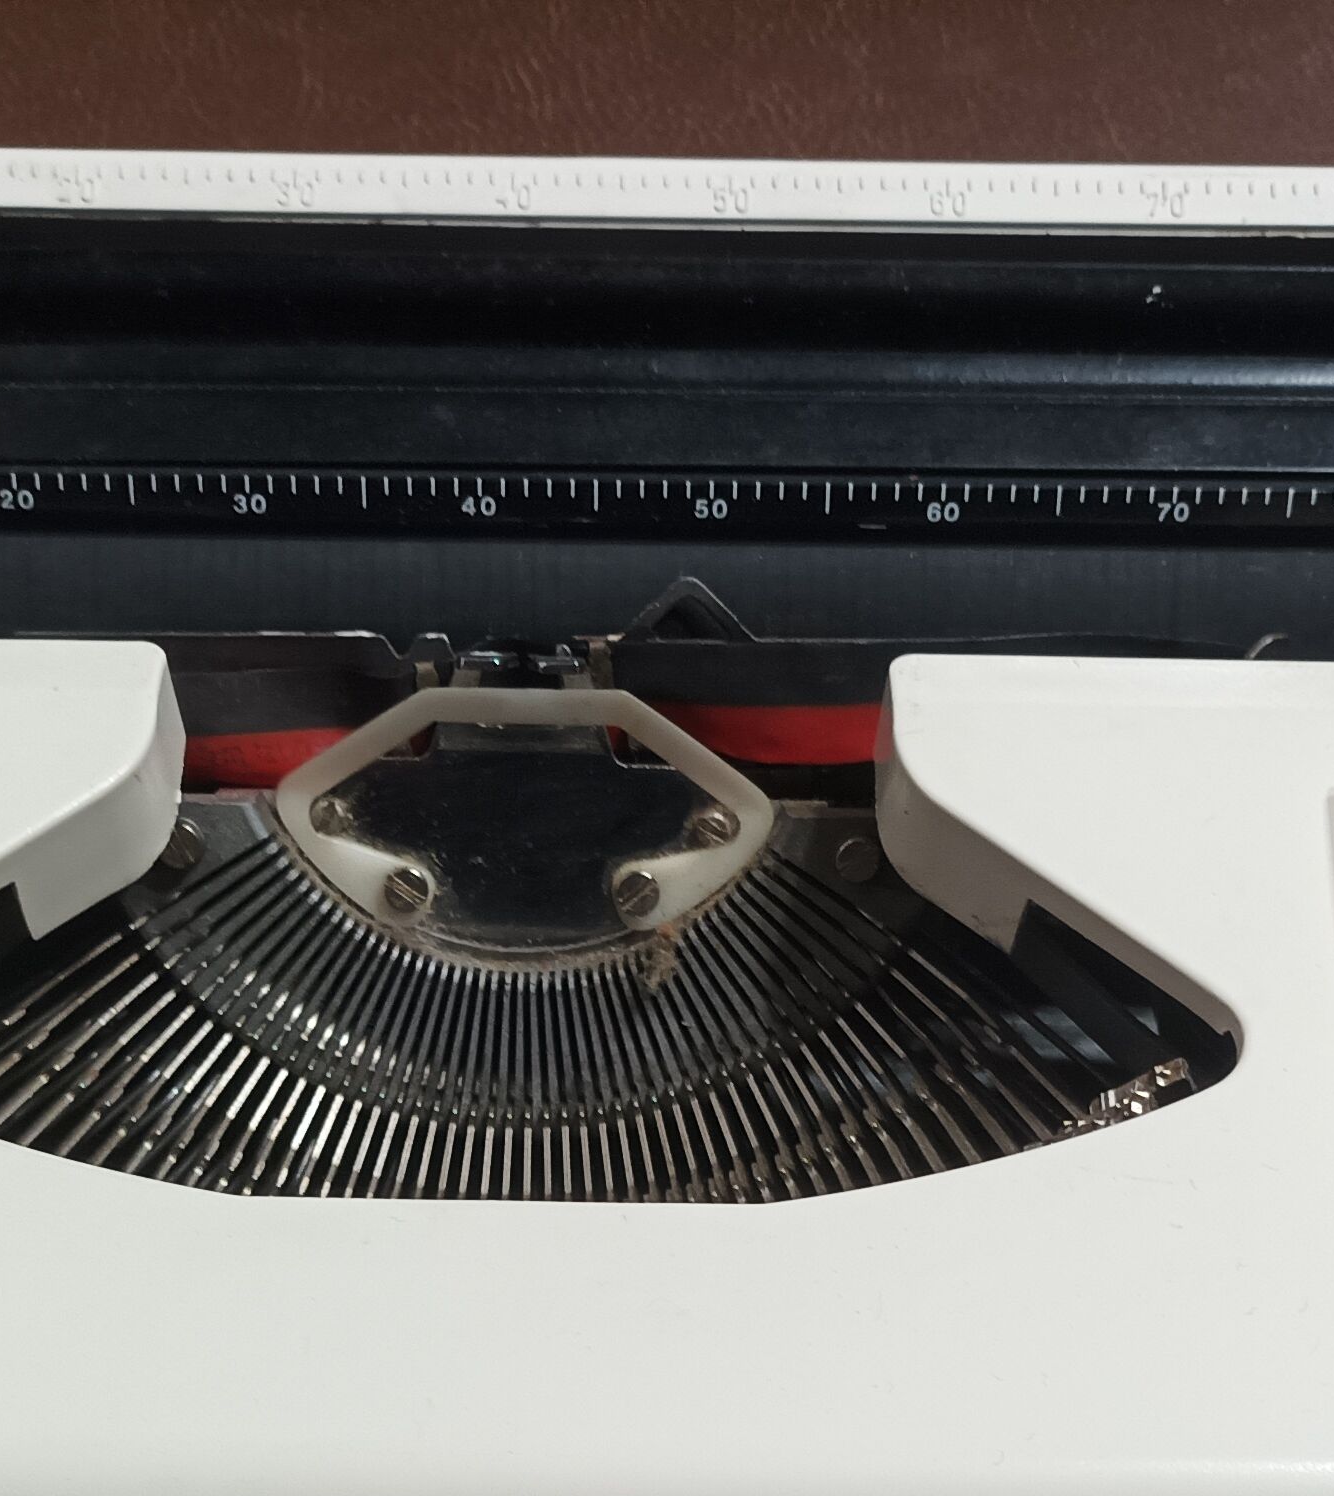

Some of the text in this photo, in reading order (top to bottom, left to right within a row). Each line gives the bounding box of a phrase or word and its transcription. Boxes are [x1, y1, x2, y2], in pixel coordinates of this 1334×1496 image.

[712, 188, 750, 214] 50
[928, 192, 968, 218] 60
[1145, 193, 1184, 219] 70
[231, 492, 268, 515] 30
[460, 495, 497, 518] 40
[693, 498, 729, 521] 50
[926, 501, 961, 524] 60
[1156, 502, 1191, 523] 70
